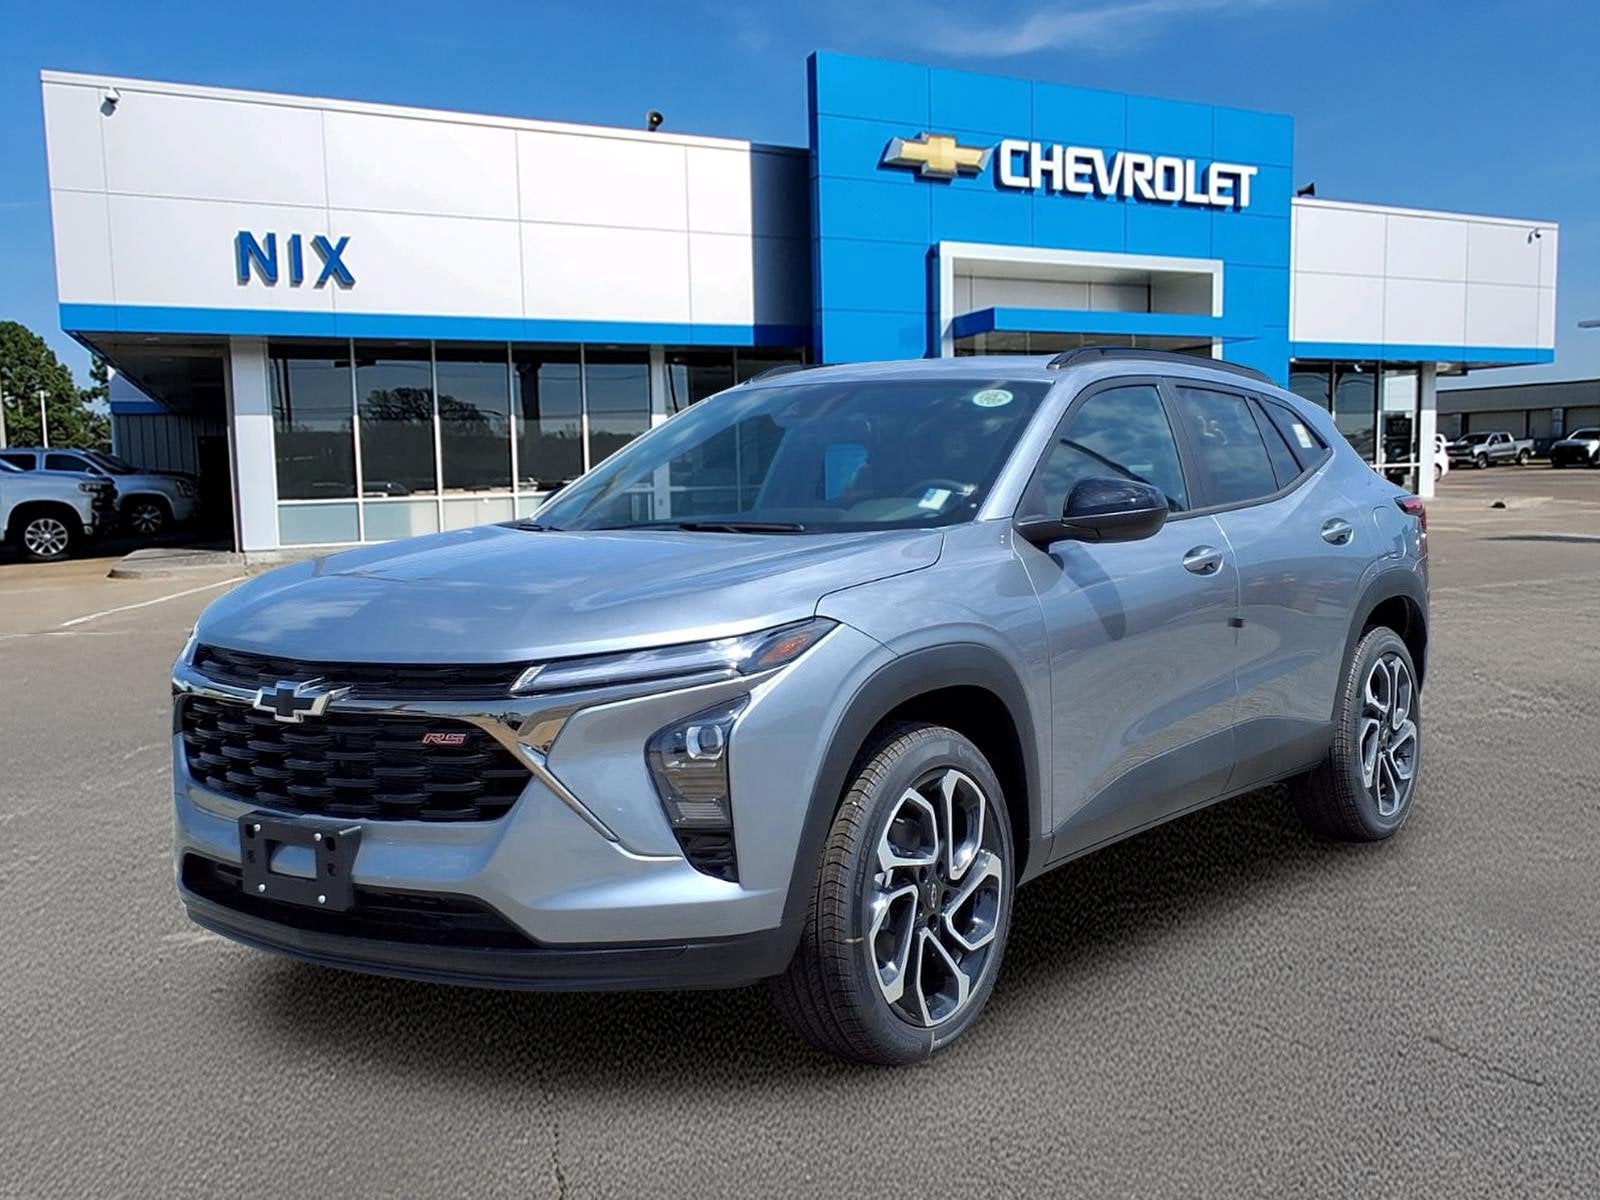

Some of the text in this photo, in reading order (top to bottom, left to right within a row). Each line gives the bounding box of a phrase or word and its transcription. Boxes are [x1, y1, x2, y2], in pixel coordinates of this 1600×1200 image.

[998, 138, 1258, 208] CHEVROLET
[234, 230, 356, 289] NIX
[422, 732, 466, 745] RS
